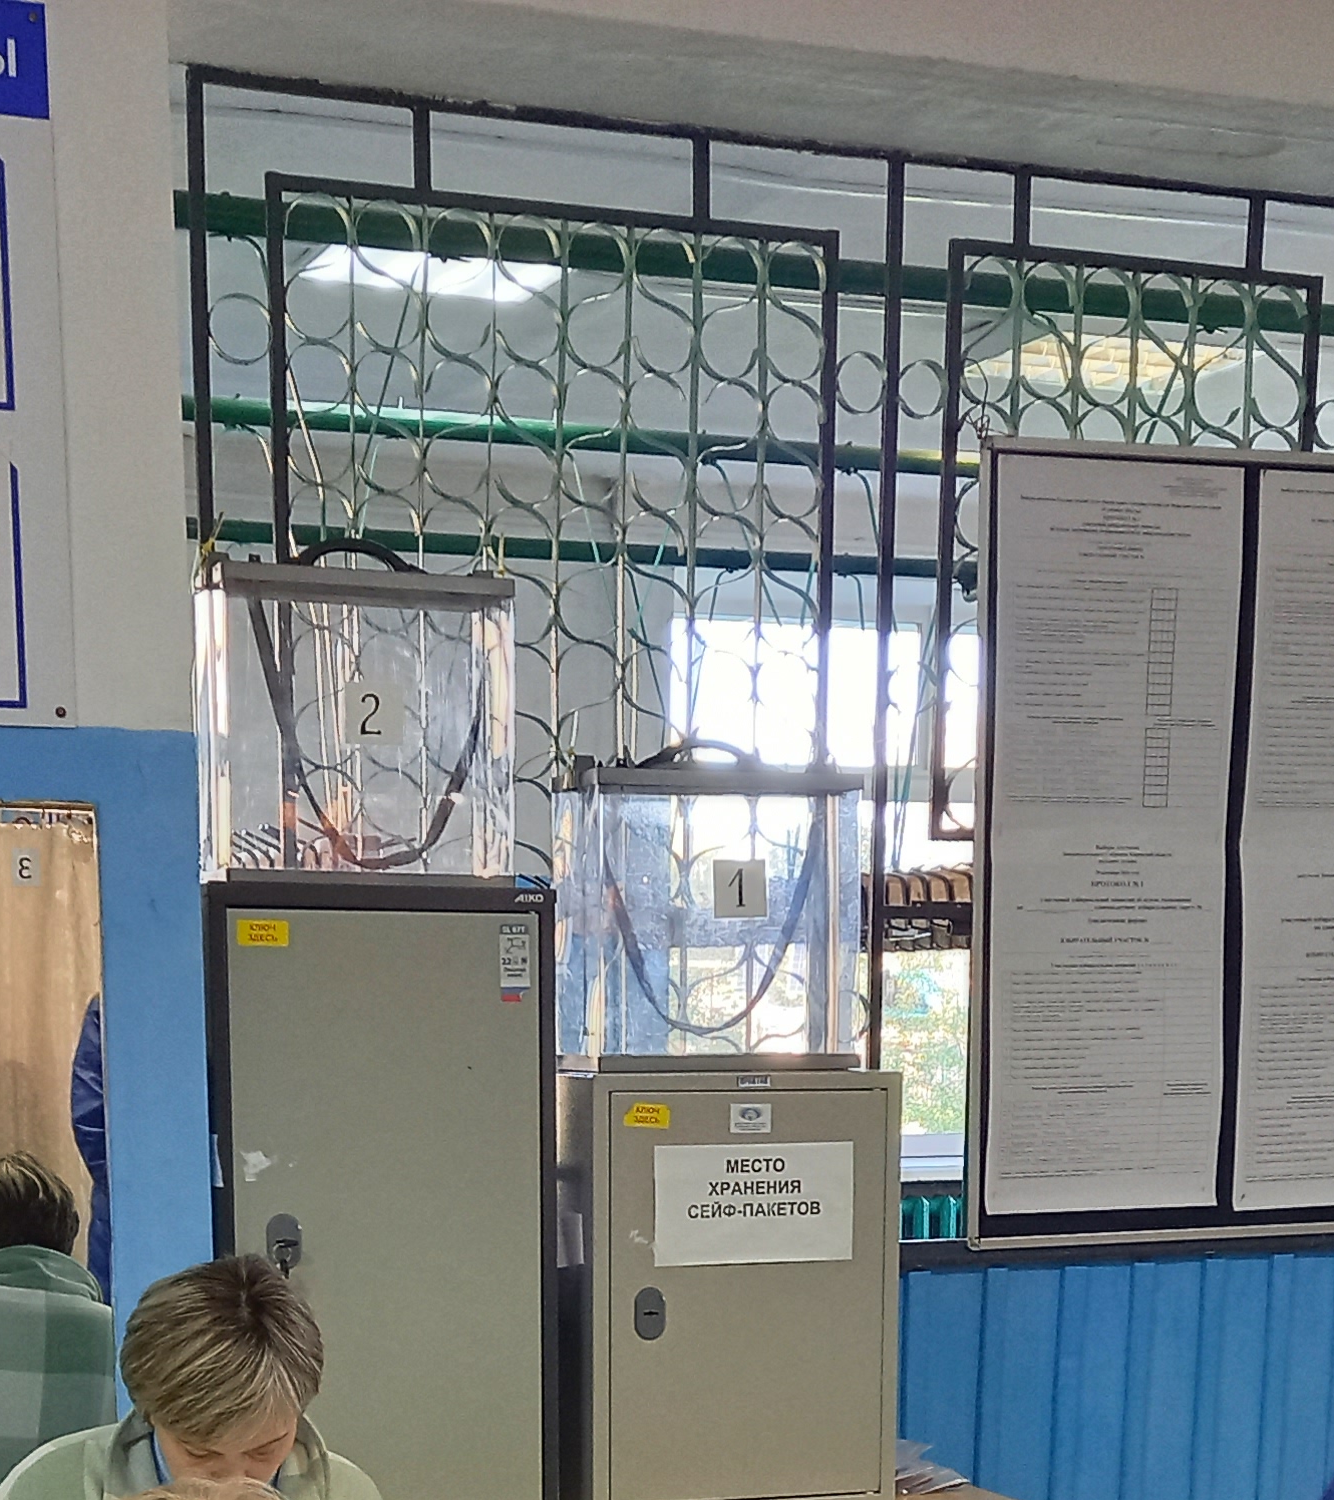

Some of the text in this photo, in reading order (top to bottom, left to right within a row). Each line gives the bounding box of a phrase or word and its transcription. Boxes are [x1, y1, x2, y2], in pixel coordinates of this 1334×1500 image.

[360, 693, 382, 735] 2
[728, 868, 746, 908] 1
[514, 893, 544, 903] AIKO
[725, 1158, 786, 1173] МЕСТО
[708, 1180, 802, 1196] ХРАНЕНИЯ
[687, 1201, 821, 1219] СЕЙФ-ПАКЕТОВ
